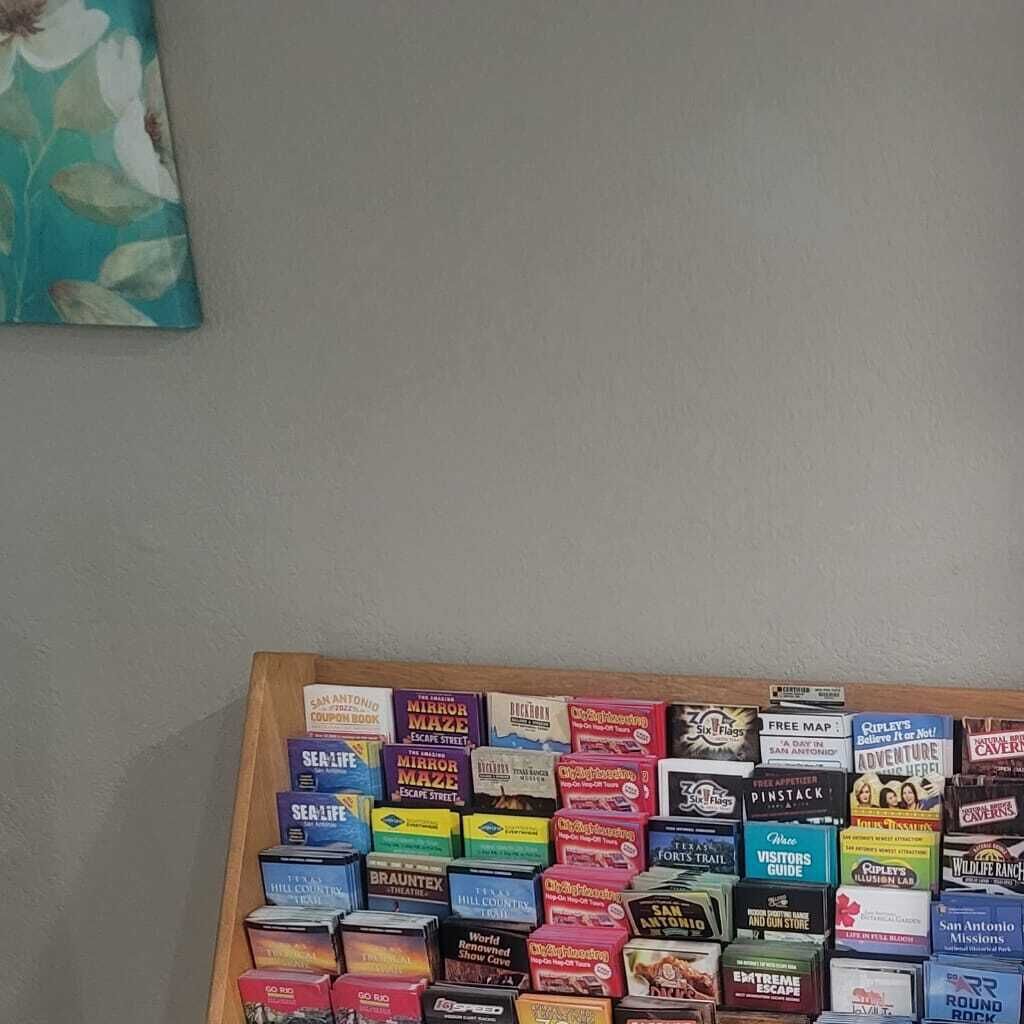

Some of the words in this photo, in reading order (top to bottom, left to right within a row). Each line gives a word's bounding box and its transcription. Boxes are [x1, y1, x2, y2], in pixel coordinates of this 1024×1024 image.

[311, 695, 331, 709] SAN
[337, 694, 379, 712] ANTONIO
[407, 701, 468, 716] MIRROR
[311, 712, 350, 723] COUPON
[351, 715, 380, 724] BOOK
[408, 715, 468, 733] MAZE
[696, 725, 712, 737] Six
[719, 726, 744, 737] Flags
[769, 721, 799, 731] FREE
[803, 722, 832, 732] MAP
[861, 720, 911, 735] RIPLEY'S
[410, 732, 439, 743] ESCAPE
[440, 734, 468, 745] STREET
[856, 731, 891, 746] Believe
[893, 730, 902, 741] It
[904, 732, 914, 740] or
[916, 728, 936, 739] Not!
[974, 736, 1010, 747] NATURAL
[397, 754, 458, 772] MIRROR
[858, 742, 939, 770] ADVENTURE
[398, 771, 459, 790] MAZE
[753, 778, 775, 787] FREE
[776, 776, 817, 786] APPETIZER
[400, 787, 428, 798] ESCAPE
[429, 790, 458, 801] STREET
[751, 786, 823, 803] PINSTACK
[960, 807, 1016, 824] CAVERNS
[767, 831, 797, 845] Waco
[658, 850, 693, 863] FORTS
[696, 854, 726, 865] TRAIL
[757, 850, 811, 865] VISITORS
[767, 865, 803, 877] GUIDE
[952, 859, 993, 879] WILDLIFE
[370, 871, 444, 890] BRAUNTEX
[855, 873, 895, 885] ILLUSION
[896, 876, 915, 886] LAB
[271, 884, 294, 893] HILL
[296, 885, 344, 896] COUNTRY
[390, 887, 425, 897] THEATRE
[651, 904, 681, 917] SAN
[641, 917, 704, 930] ANTONIO
[749, 917, 766, 927] AND
[766, 917, 782, 928] GUN
[784, 918, 810, 930] STORE
[939, 919, 962, 932] San
[963, 920, 1014, 932] Antonio
[469, 931, 500, 945] World
[950, 932, 1005, 945] Missions
[458, 940, 511, 957] Renowned
[458, 950, 485, 961] Show
[487, 954, 511, 967] Cave
[757, 983, 801, 996] ESCAPE
[945, 995, 1002, 1012] ROUND
[951, 1011, 997, 1024] ROCK
